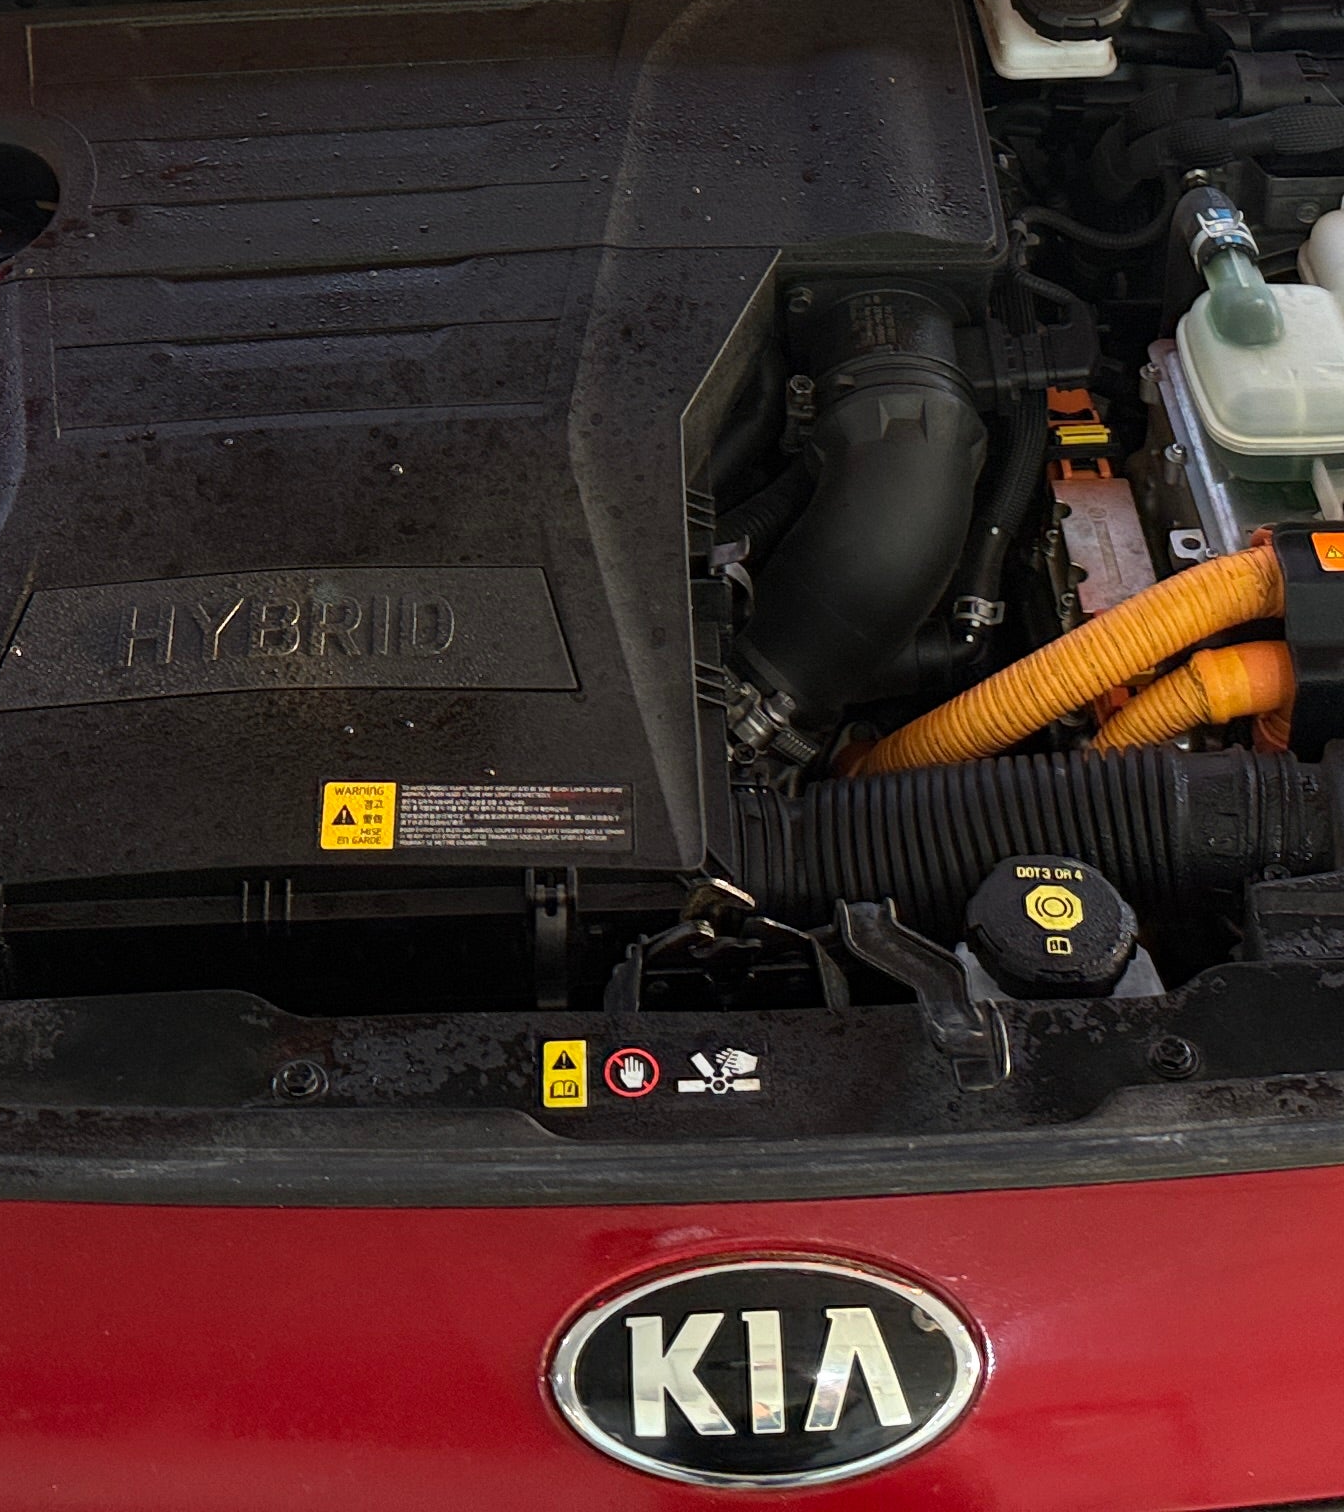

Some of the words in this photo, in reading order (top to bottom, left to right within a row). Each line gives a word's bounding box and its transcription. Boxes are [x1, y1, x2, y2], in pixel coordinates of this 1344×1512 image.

[119, 594, 455, 667] HYBRID
[334, 786, 385, 796] WARNING
[360, 828, 382, 836] MISE
[337, 836, 349, 845] EN
[351, 836, 382, 845] GARDE
[1054, 868, 1073, 880] OR
[1074, 869, 1084, 882] 4
[625, 1307, 912, 1437] KIA
